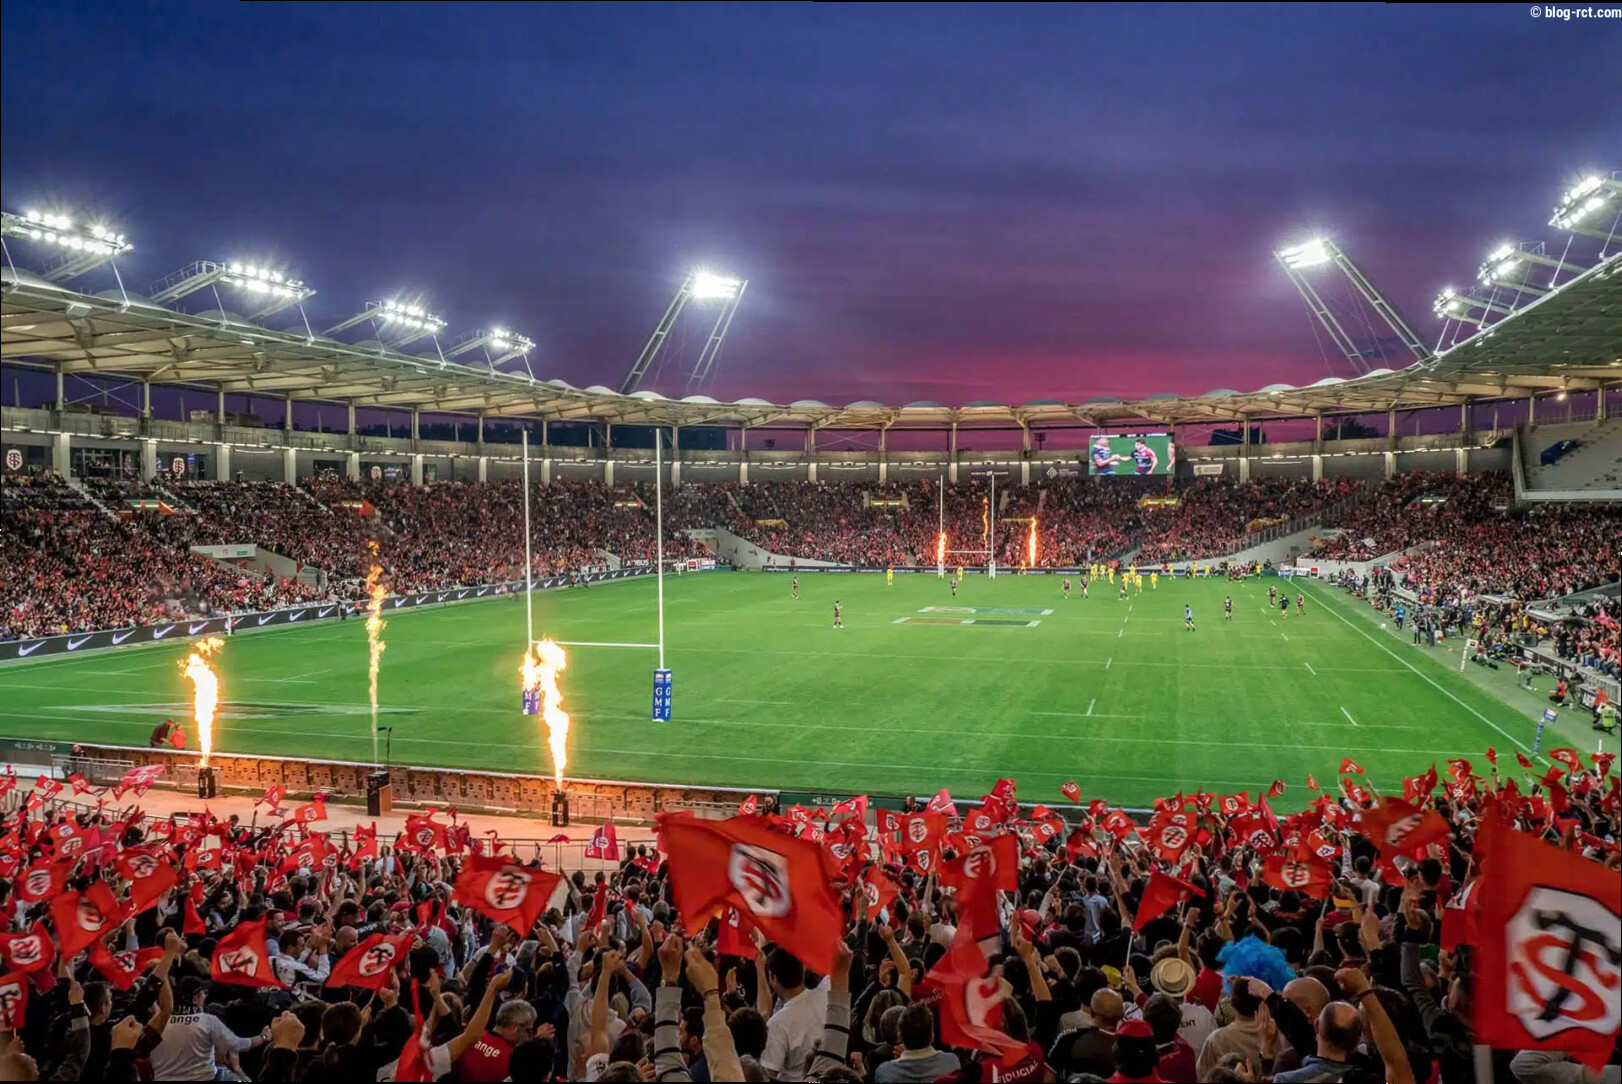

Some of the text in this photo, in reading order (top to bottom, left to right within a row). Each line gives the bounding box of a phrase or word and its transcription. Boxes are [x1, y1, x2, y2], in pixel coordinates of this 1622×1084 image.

[626, 559, 649, 567] ABUS
[357, 923, 377, 933] range
[170, 1015, 200, 1025] ange
[474, 1040, 500, 1058] ange
